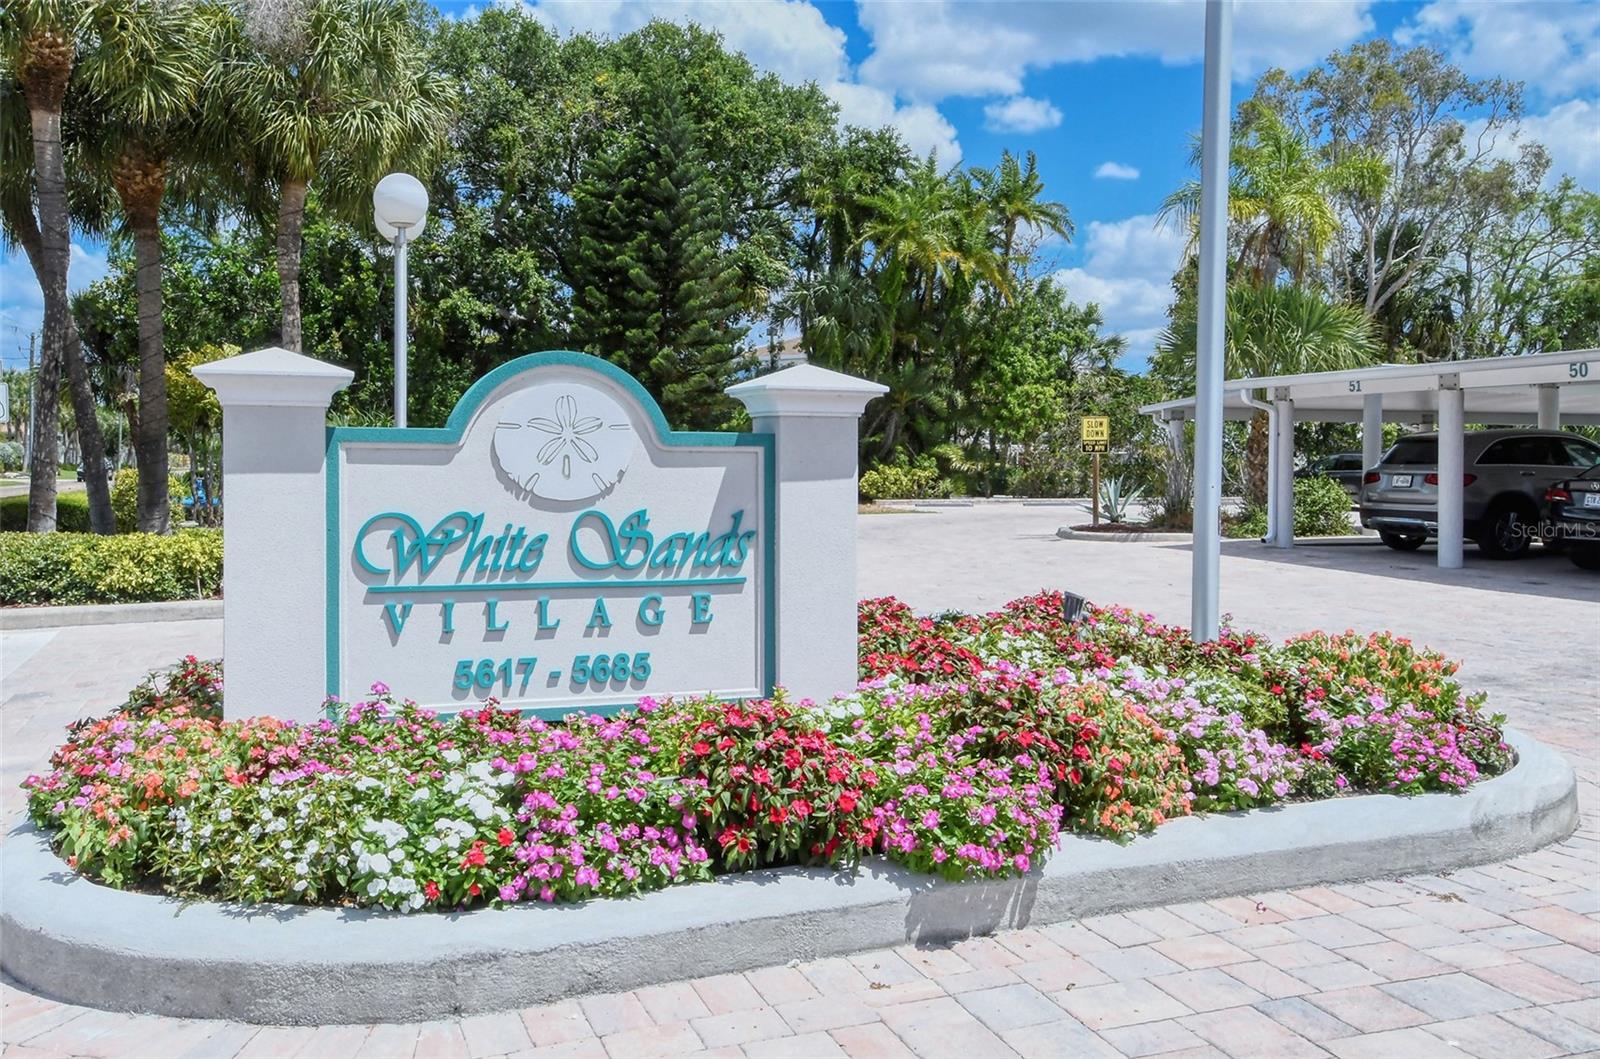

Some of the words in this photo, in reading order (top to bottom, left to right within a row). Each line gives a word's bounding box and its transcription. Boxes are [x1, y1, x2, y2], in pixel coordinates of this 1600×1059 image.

[1568, 362, 1588, 378] 50
[1348, 380, 1362, 392] 51
[1086, 420, 1103, 428] SLOW
[1086, 430, 1104, 438] DOWN
[354, 511, 549, 575] White
[569, 508, 757, 571] Sands
[384, 592, 714, 635] VILLAGE
[455, 656, 538, 690] 5617
[547, 671, 562, 680] -
[571, 652, 652, 684] 5685
